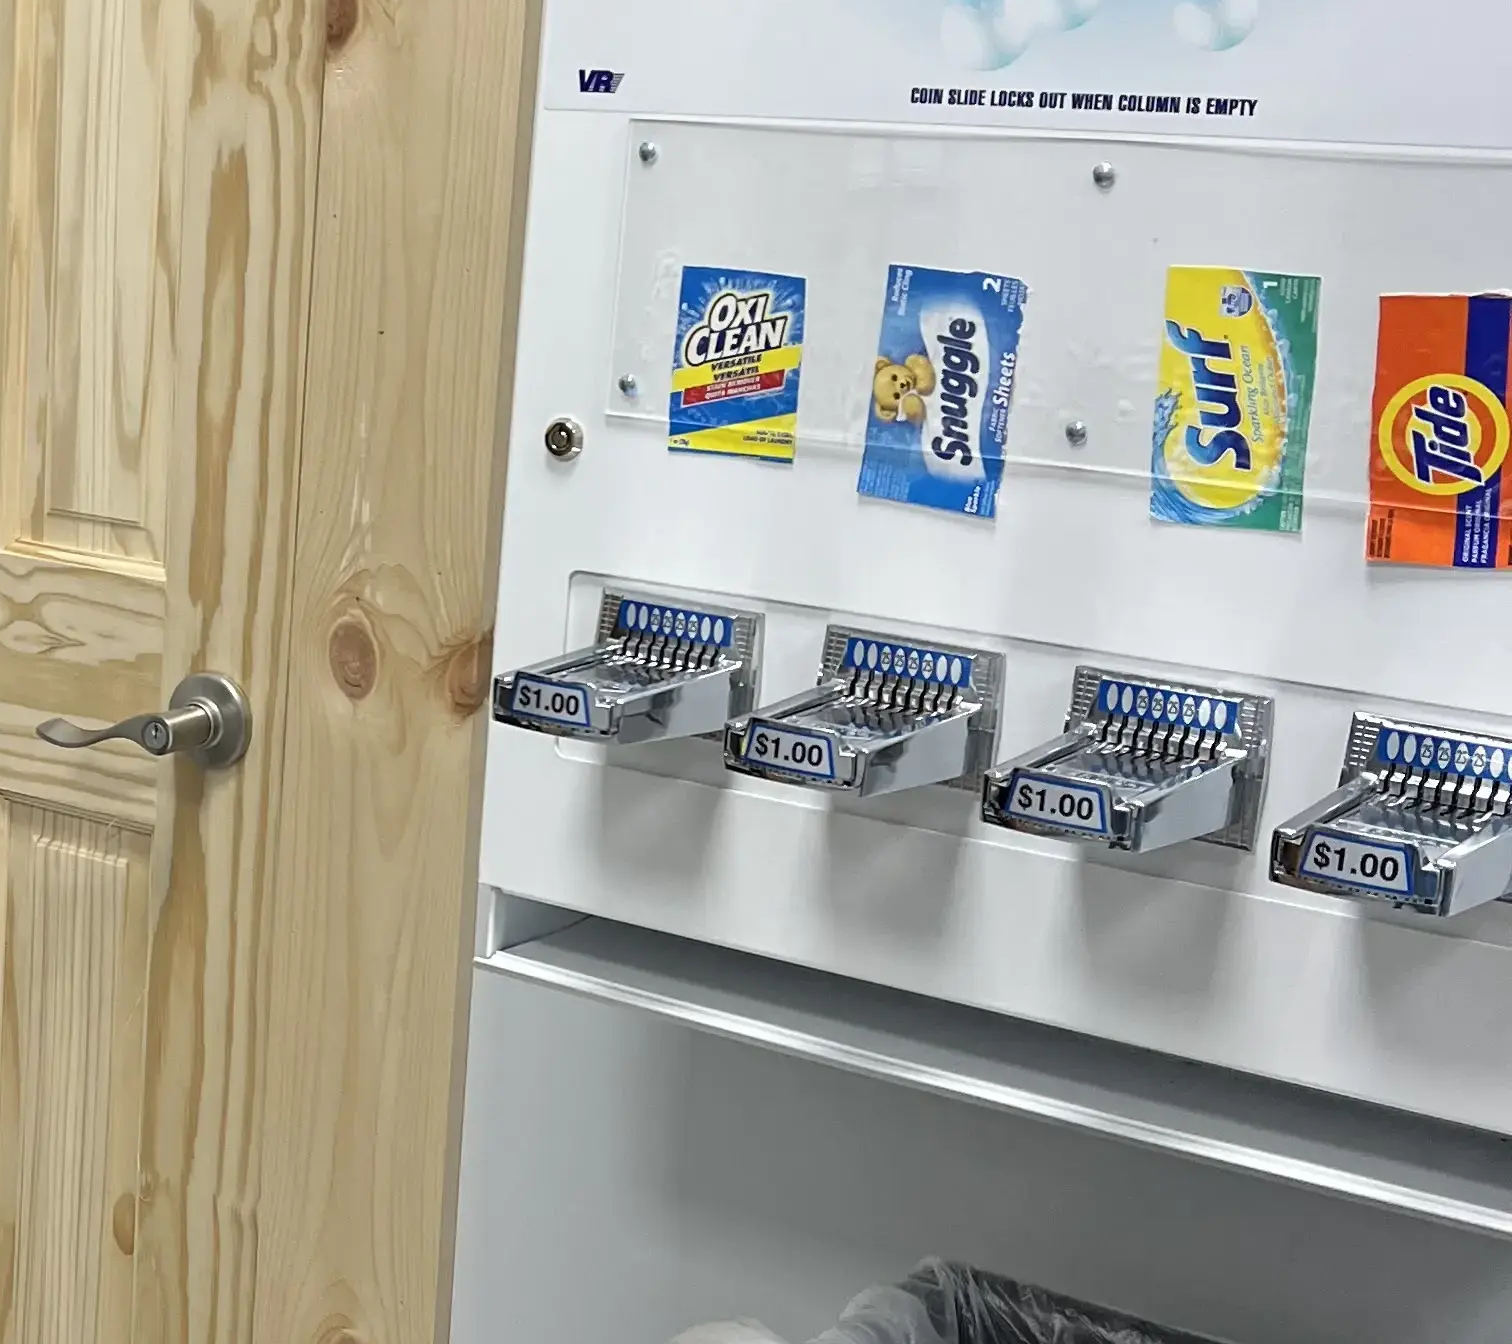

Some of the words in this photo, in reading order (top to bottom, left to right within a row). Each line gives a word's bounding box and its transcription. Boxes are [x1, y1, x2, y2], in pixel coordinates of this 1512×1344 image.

[911, 87, 943, 105] COIN
[948, 89, 986, 106] SLIDE
[990, 90, 1034, 108] LOCKS
[1039, 92, 1068, 109] OUT
[1071, 93, 1113, 111] WHEN
[1118, 95, 1180, 114] COLUMN
[1185, 97, 1201, 114] IS
[1206, 98, 1258, 117] EMPTY
[982, 277, 1001, 292] 2
[1263, 280, 1278, 289] 1
[709, 293, 770, 332] OXI
[685, 315, 788, 366] CLEAN
[711, 354, 762, 372] VERSATILE
[992, 352, 1015, 407] Sheets
[1240, 345, 1254, 384] Ocean
[931, 317, 980, 466] Snuggle
[1165, 320, 1251, 470] Surf
[988, 407, 999, 432] FABRIC
[1246, 387, 1264, 443] Sparkling
[1411, 384, 1485, 486] Tide
[1462, 528, 1472, 563] ORIGINAL
[1471, 534, 1480, 563] PARFUM
[881, 652, 891, 665] 25
[894, 654, 905, 667] 25
[908, 657, 919, 670] 25
[922, 659, 933, 672] 25
[519, 684, 579, 716] $1.00
[1138, 695, 1148, 709] 25
[1153, 698, 1163, 712] 25
[1168, 701, 1179, 714] 25
[1184, 703, 1194, 717] 25
[754, 732, 823, 767] $1.00
[1422, 743, 1433, 758] 25
[1439, 746, 1450, 761] 25
[1455, 749, 1468, 764] 25
[1474, 752, 1486, 768] 25
[1018, 784, 1094, 820] $1.00
[1313, 841, 1399, 881] $1.00
